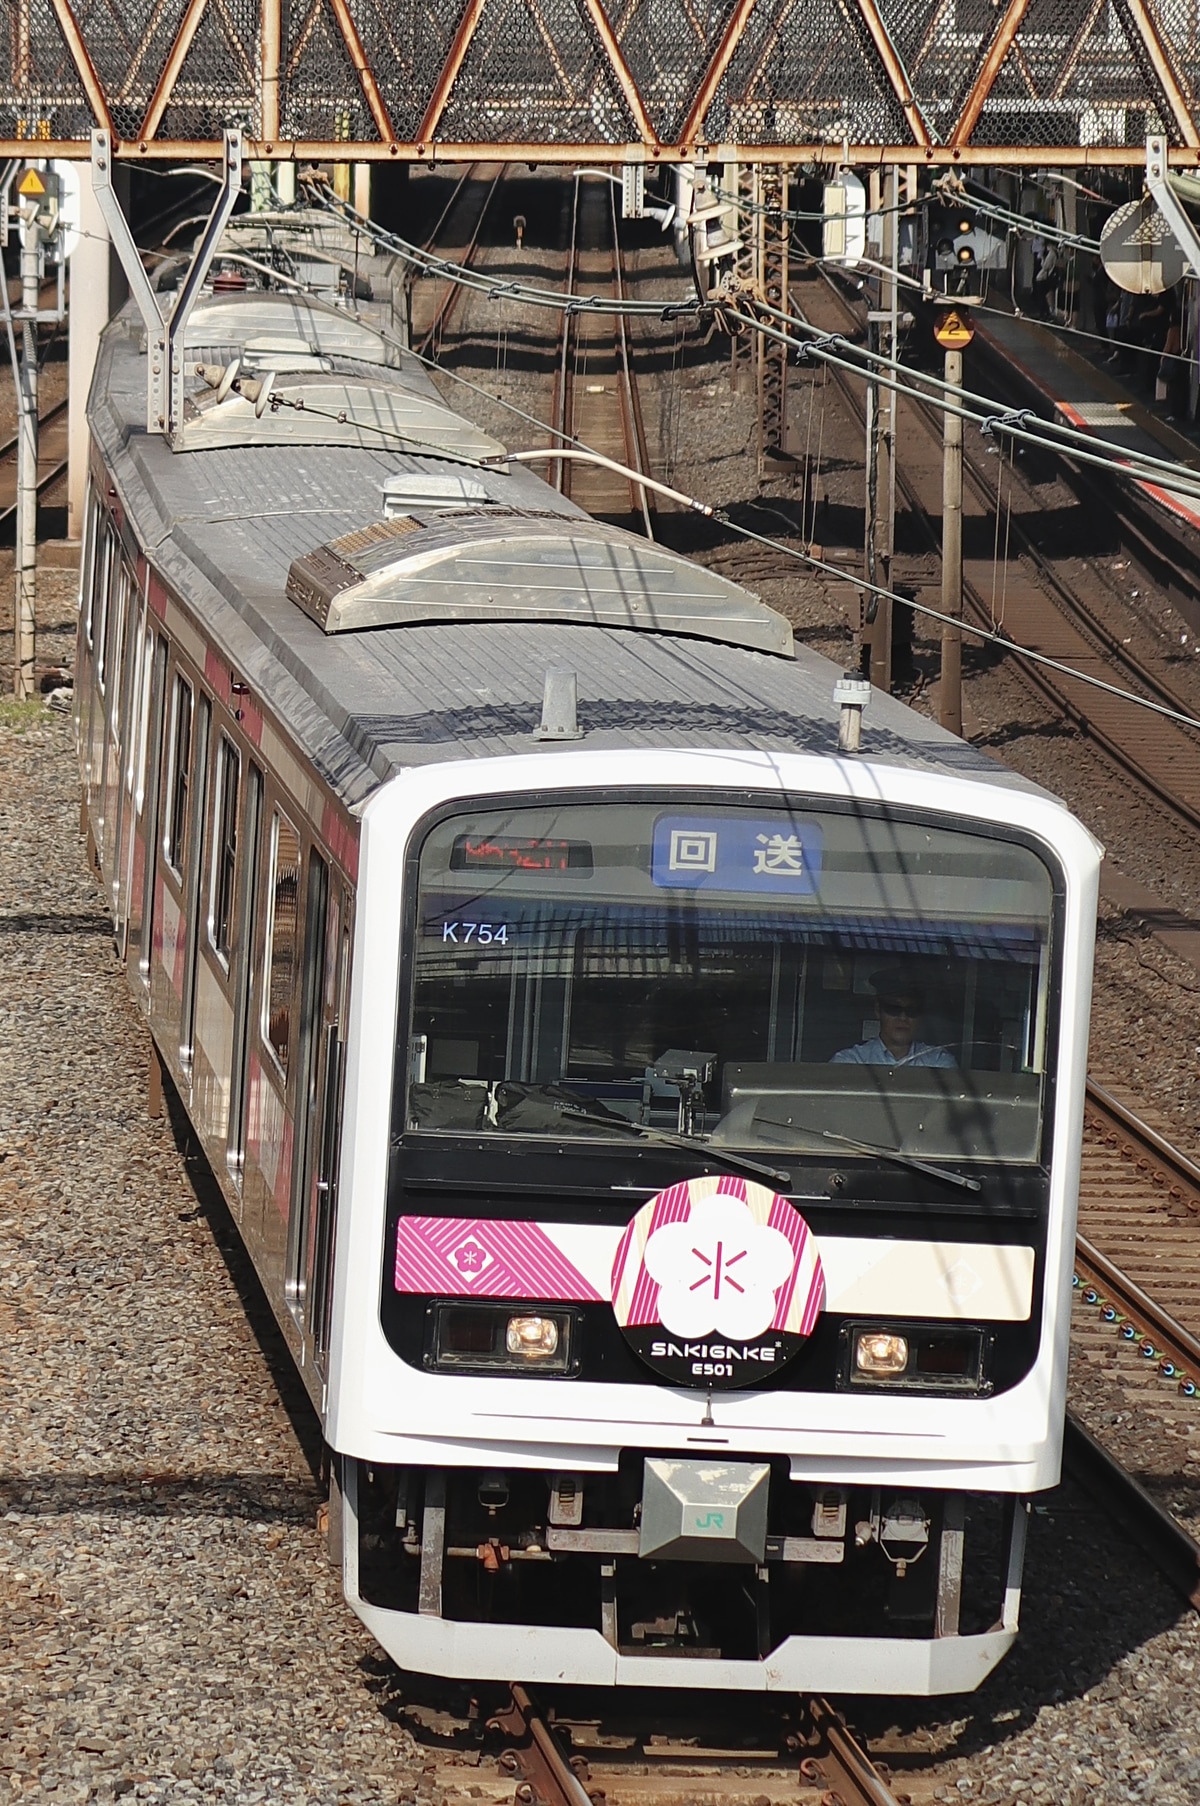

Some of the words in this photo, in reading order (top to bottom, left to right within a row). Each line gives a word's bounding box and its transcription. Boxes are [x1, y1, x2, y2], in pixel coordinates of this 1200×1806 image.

[948, 321, 960, 336] 2
[669, 829, 802, 876] 回送
[442, 921, 509, 945] K754
[651, 1342, 776, 1361] SAKIGAKE
[691, 1363, 733, 1376] E501
[696, 1512, 724, 1529] JR
